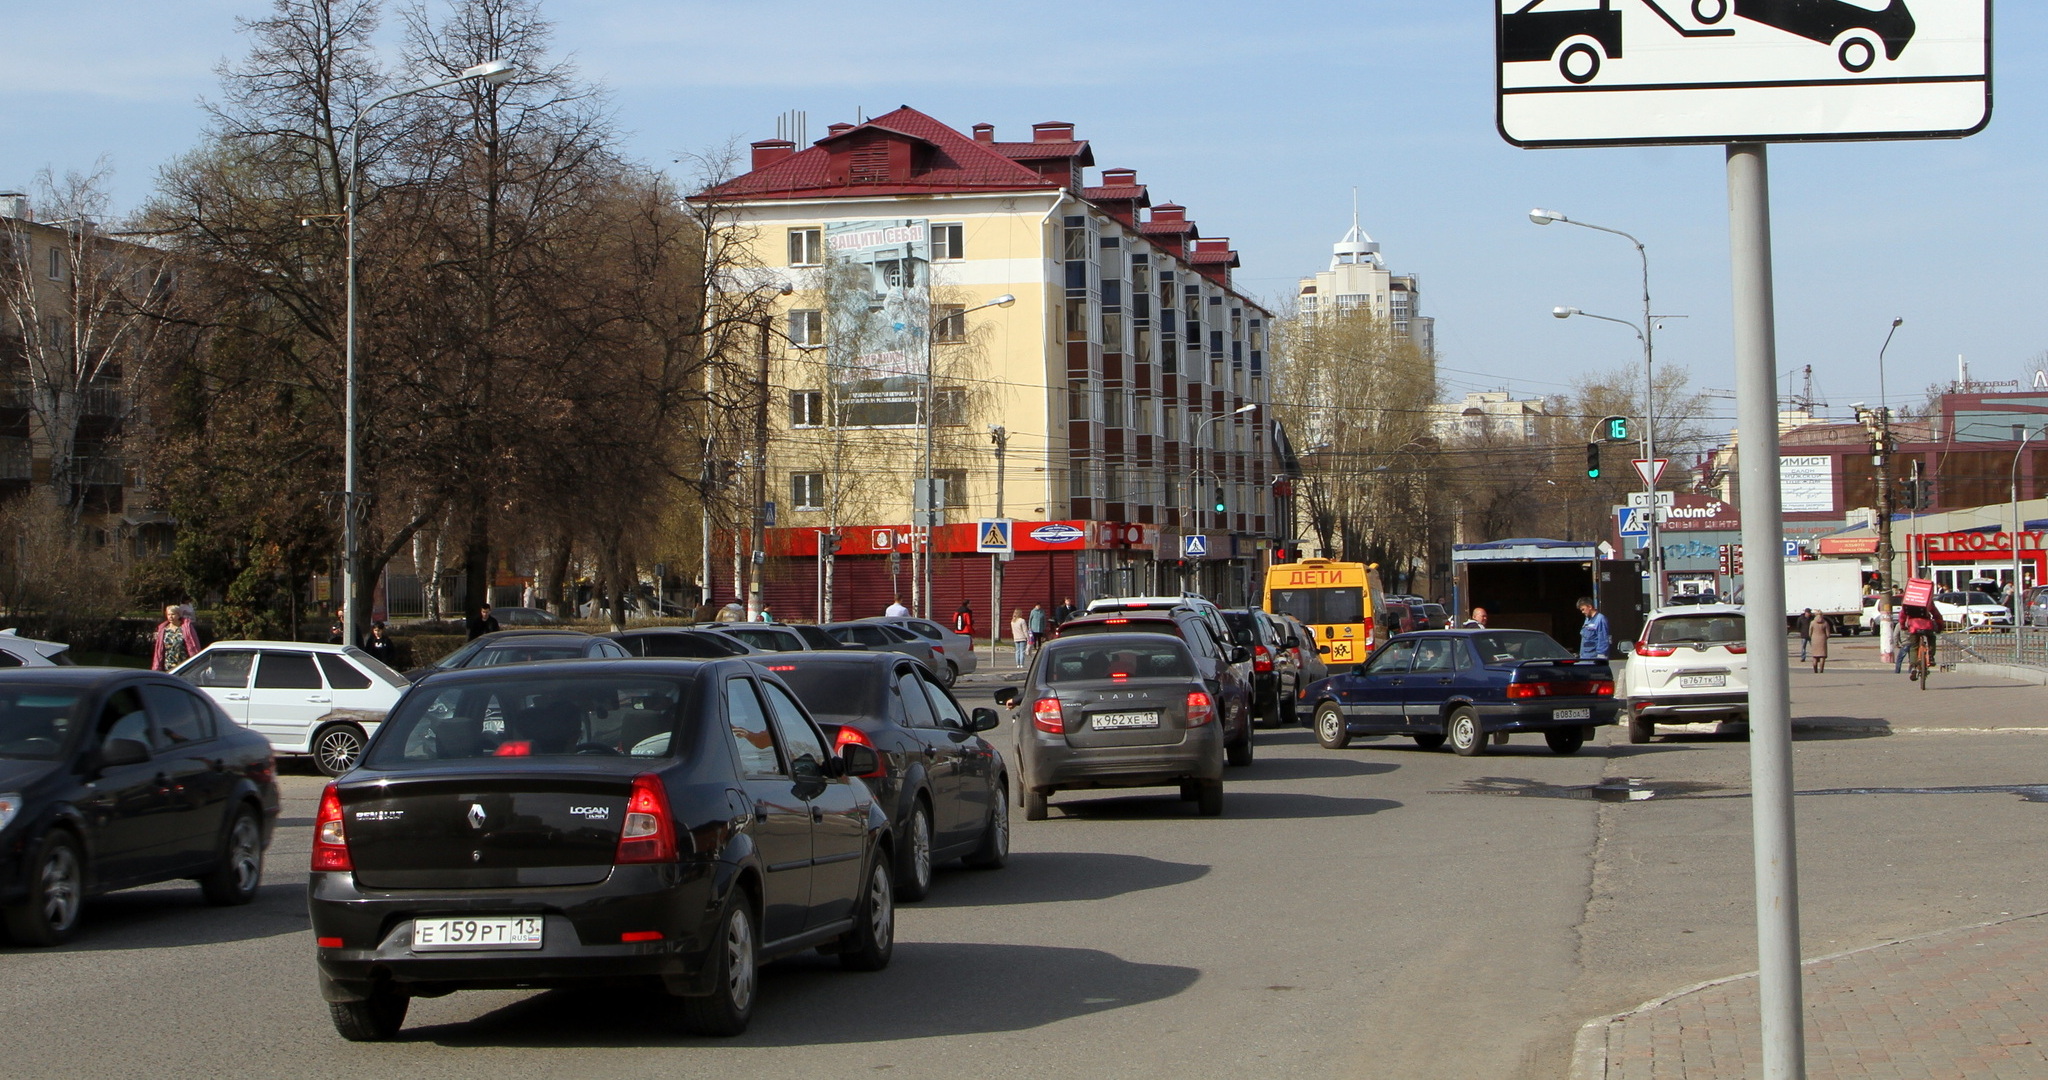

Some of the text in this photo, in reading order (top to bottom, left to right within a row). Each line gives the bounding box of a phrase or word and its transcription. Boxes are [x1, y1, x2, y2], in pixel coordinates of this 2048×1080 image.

[829, 226, 923, 250] ЗАЩИТИ СЕБЯ!
[1611, 419, 1626, 438] 16
[1780, 457, 1828, 466] ИМИСТ
[1786, 542, 1796, 555] P
[1906, 531, 2044, 551] METRO-CITY
[1290, 570, 1342, 585] ДЕТИ
[1100, 692, 1148, 700] LADA
[570, 806, 609, 814] LOGAN
[515, 919, 535, 934] 13
